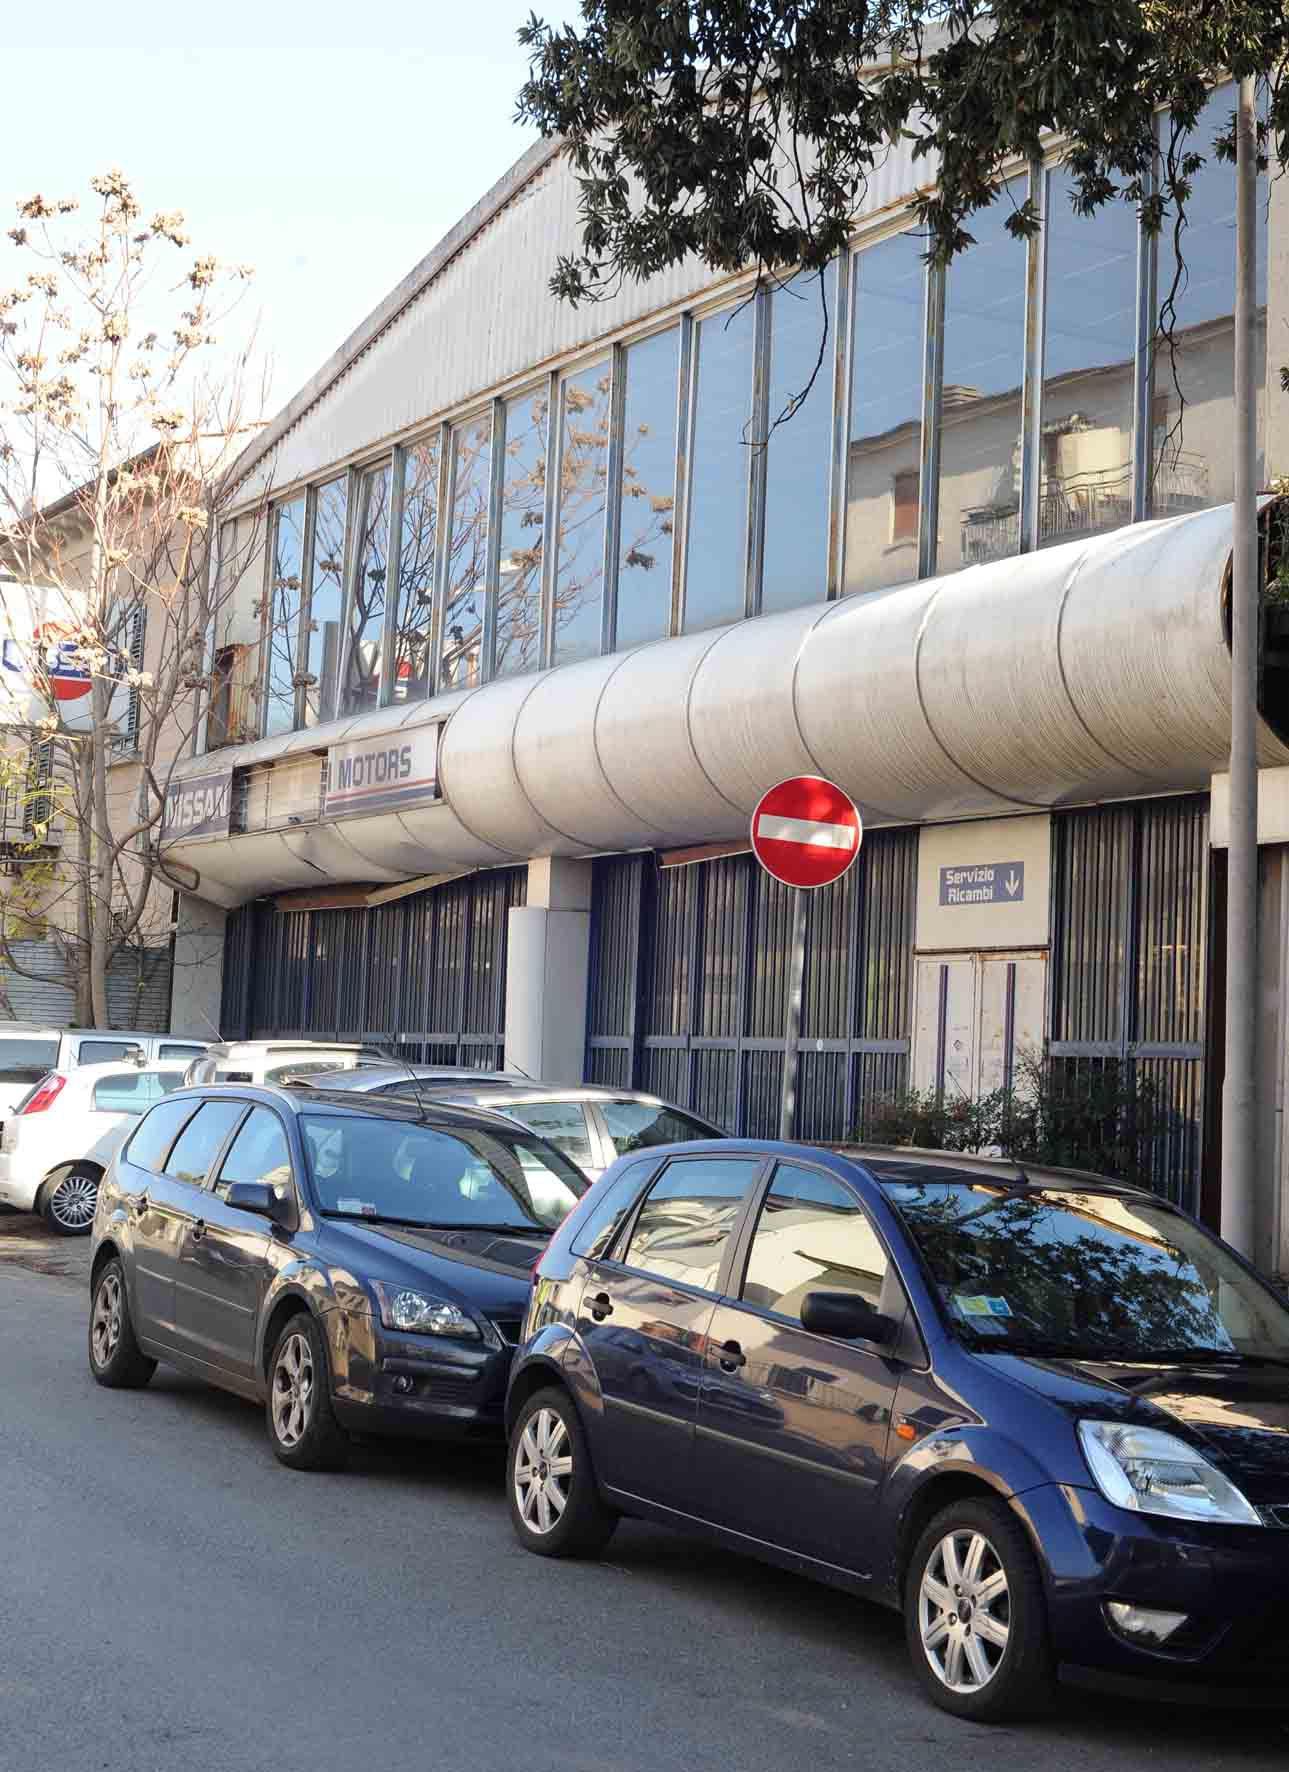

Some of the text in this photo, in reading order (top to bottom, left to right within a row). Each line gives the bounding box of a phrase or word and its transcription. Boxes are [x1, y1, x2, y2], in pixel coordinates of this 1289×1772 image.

[338, 745, 411, 790] MOTORS
[164, 784, 230, 828] NISSAN
[945, 866, 995, 885] Servizio
[947, 885, 993, 903] Ricambi
